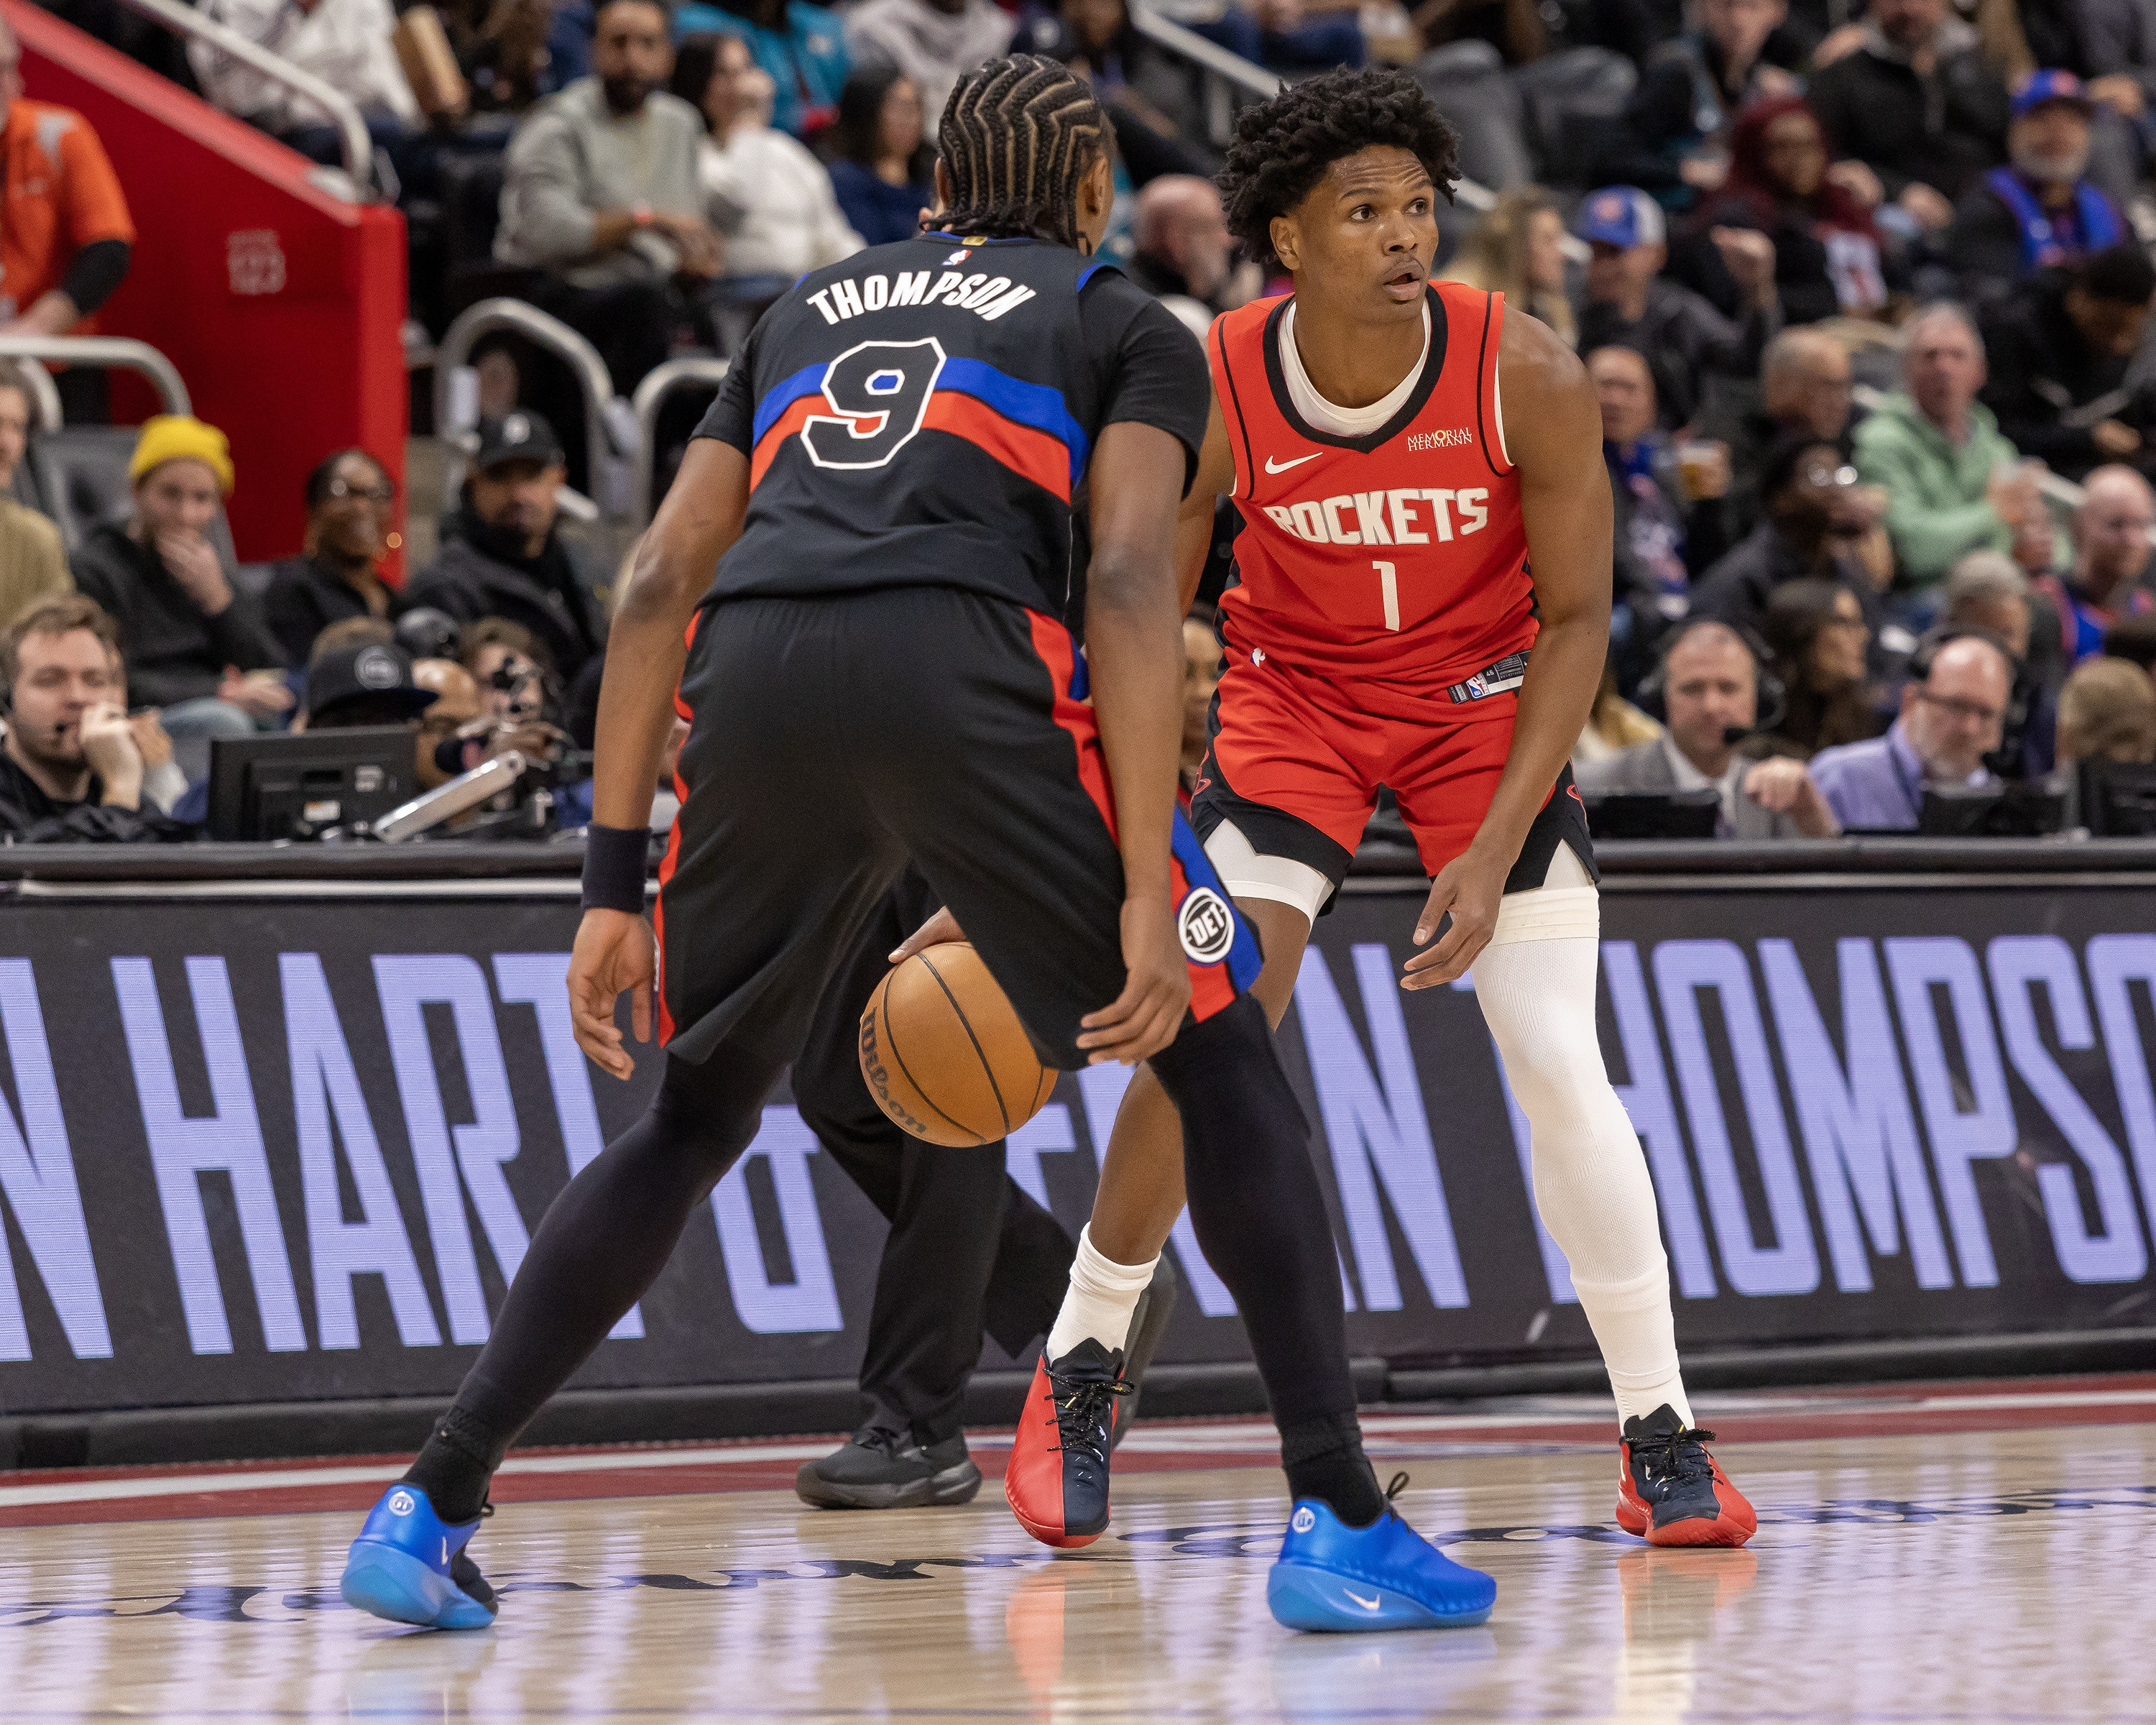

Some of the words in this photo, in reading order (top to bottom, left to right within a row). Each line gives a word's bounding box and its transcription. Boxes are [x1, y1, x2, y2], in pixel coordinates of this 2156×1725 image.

[806, 271, 1036, 325] THOMPSON
[801, 336, 946, 469] 9
[1407, 427, 1473, 445] MEMORIAL
[1408, 435, 1473, 452] HERMANN
[1262, 487, 1489, 546] ROCKETS
[1372, 561, 1400, 632] 1
[1187, 902, 1225, 947] DET
[862, 1006, 927, 1134] Wilson
